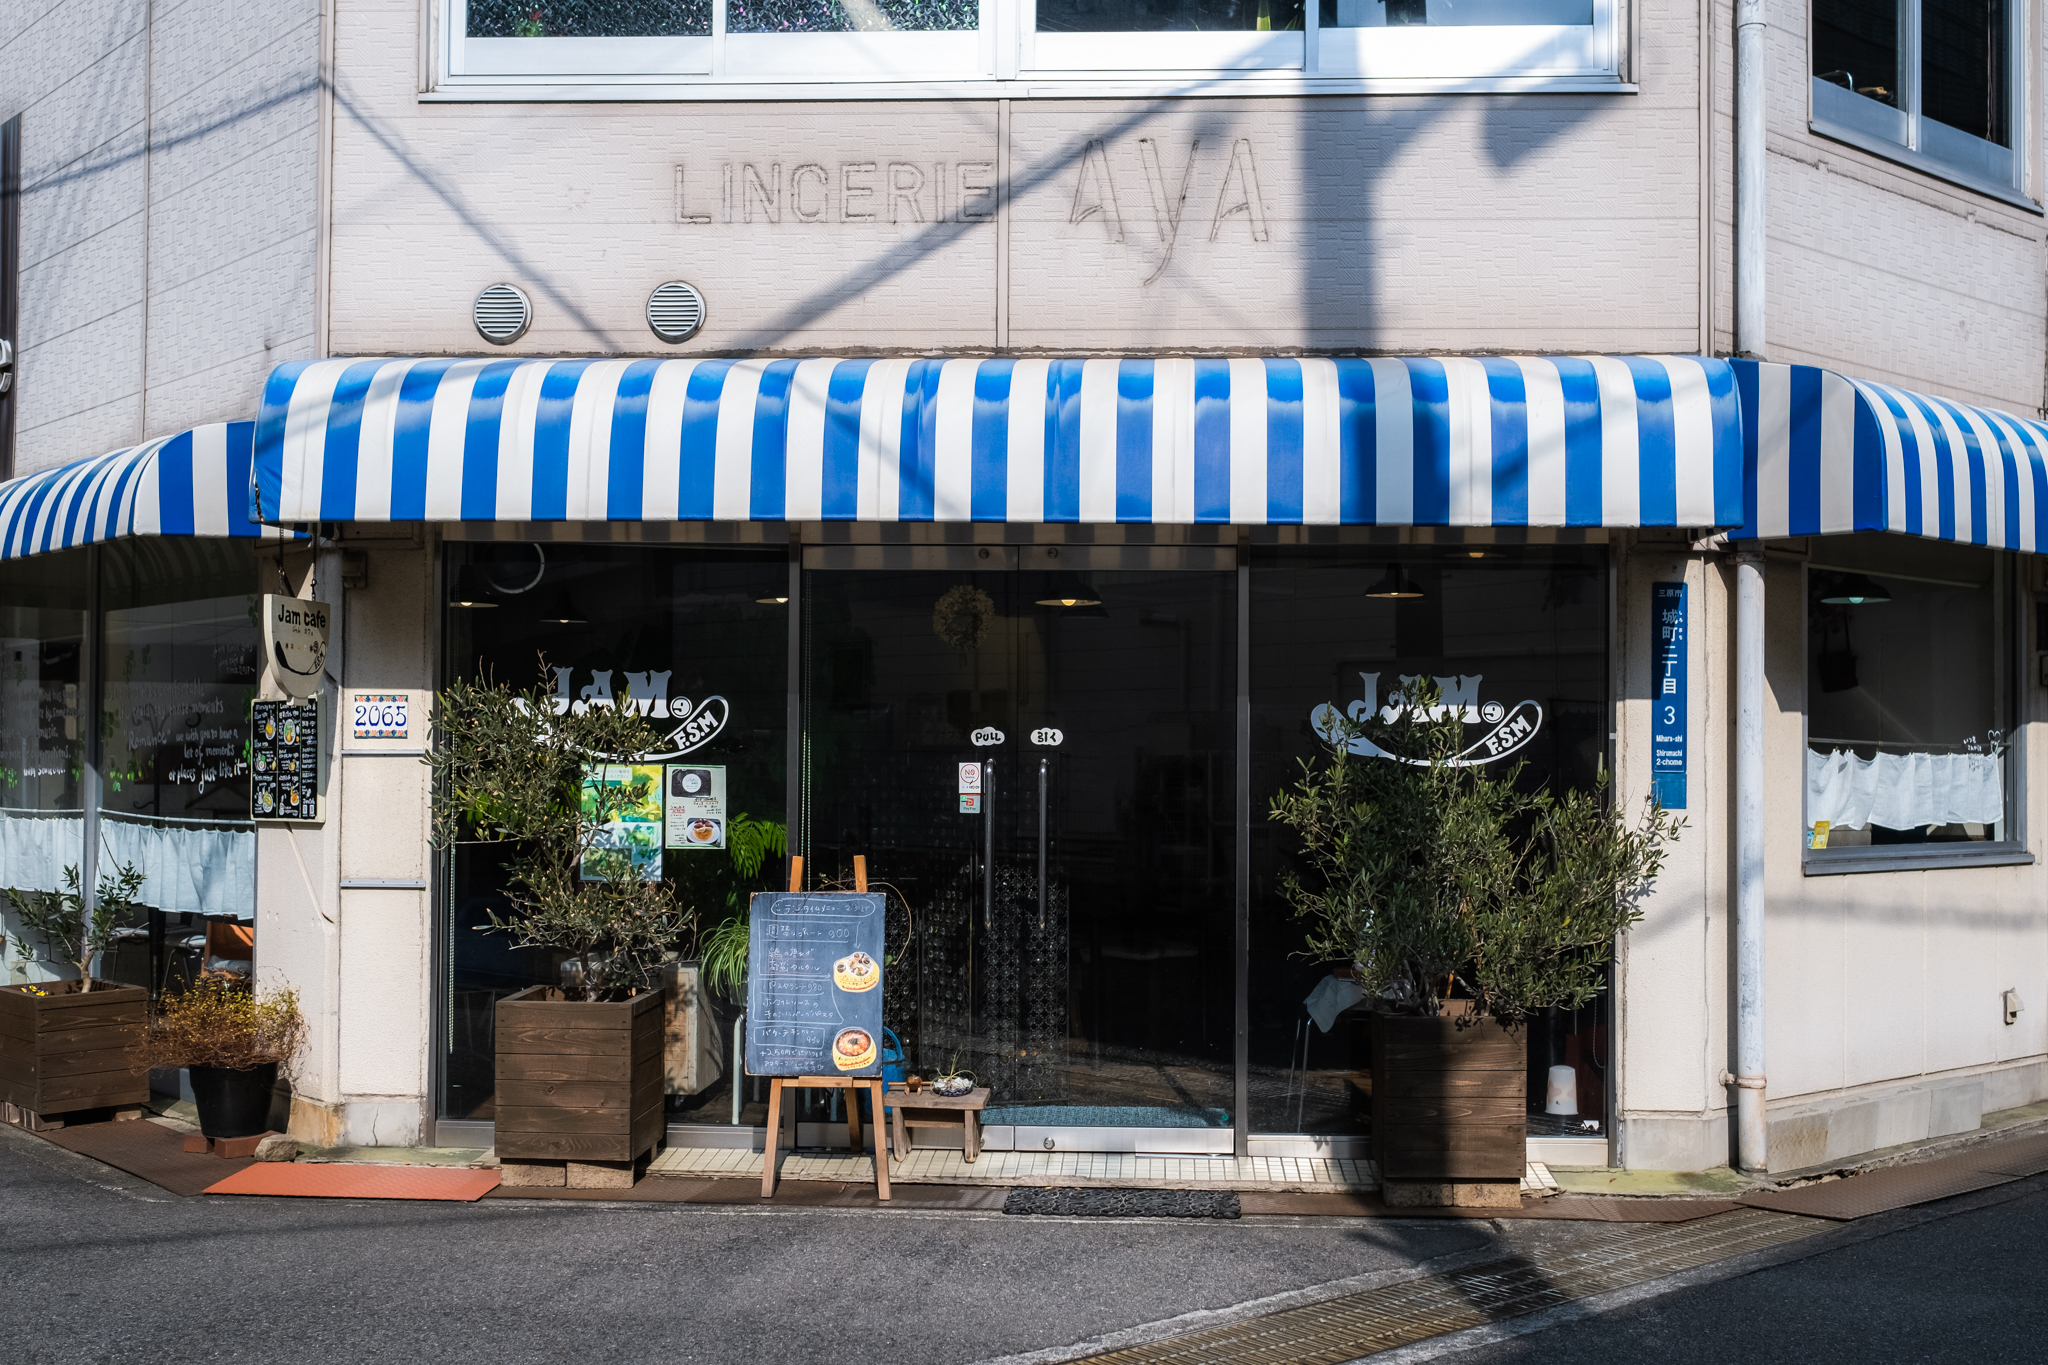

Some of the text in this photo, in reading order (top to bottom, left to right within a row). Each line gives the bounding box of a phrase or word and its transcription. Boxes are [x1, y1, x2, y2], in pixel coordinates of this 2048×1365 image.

[673, 161, 995, 226] LINGERIE
[1658, 589, 1683, 598] 三原市
[278, 604, 326, 629] Jam cafe
[1662, 608, 1678, 725] 城町二丁目 3
[354, 704, 408, 728] 2065
[219, 726, 232, 740] have
[673, 710, 719, 750] F.S.M
[975, 732, 1002, 742] PULL
[1486, 714, 1532, 756] F.S.M
[1656, 734, 1683, 743] Mihara-shi
[194, 747, 204, 764] of
[1656, 749, 1683, 757] Shiromachi
[1656, 758, 1683, 766] 2-chome
[177, 764, 196, 784] places
[198, 764, 217, 794] just
[219, 760, 233, 779] like
[828, 928, 850, 939] 900
